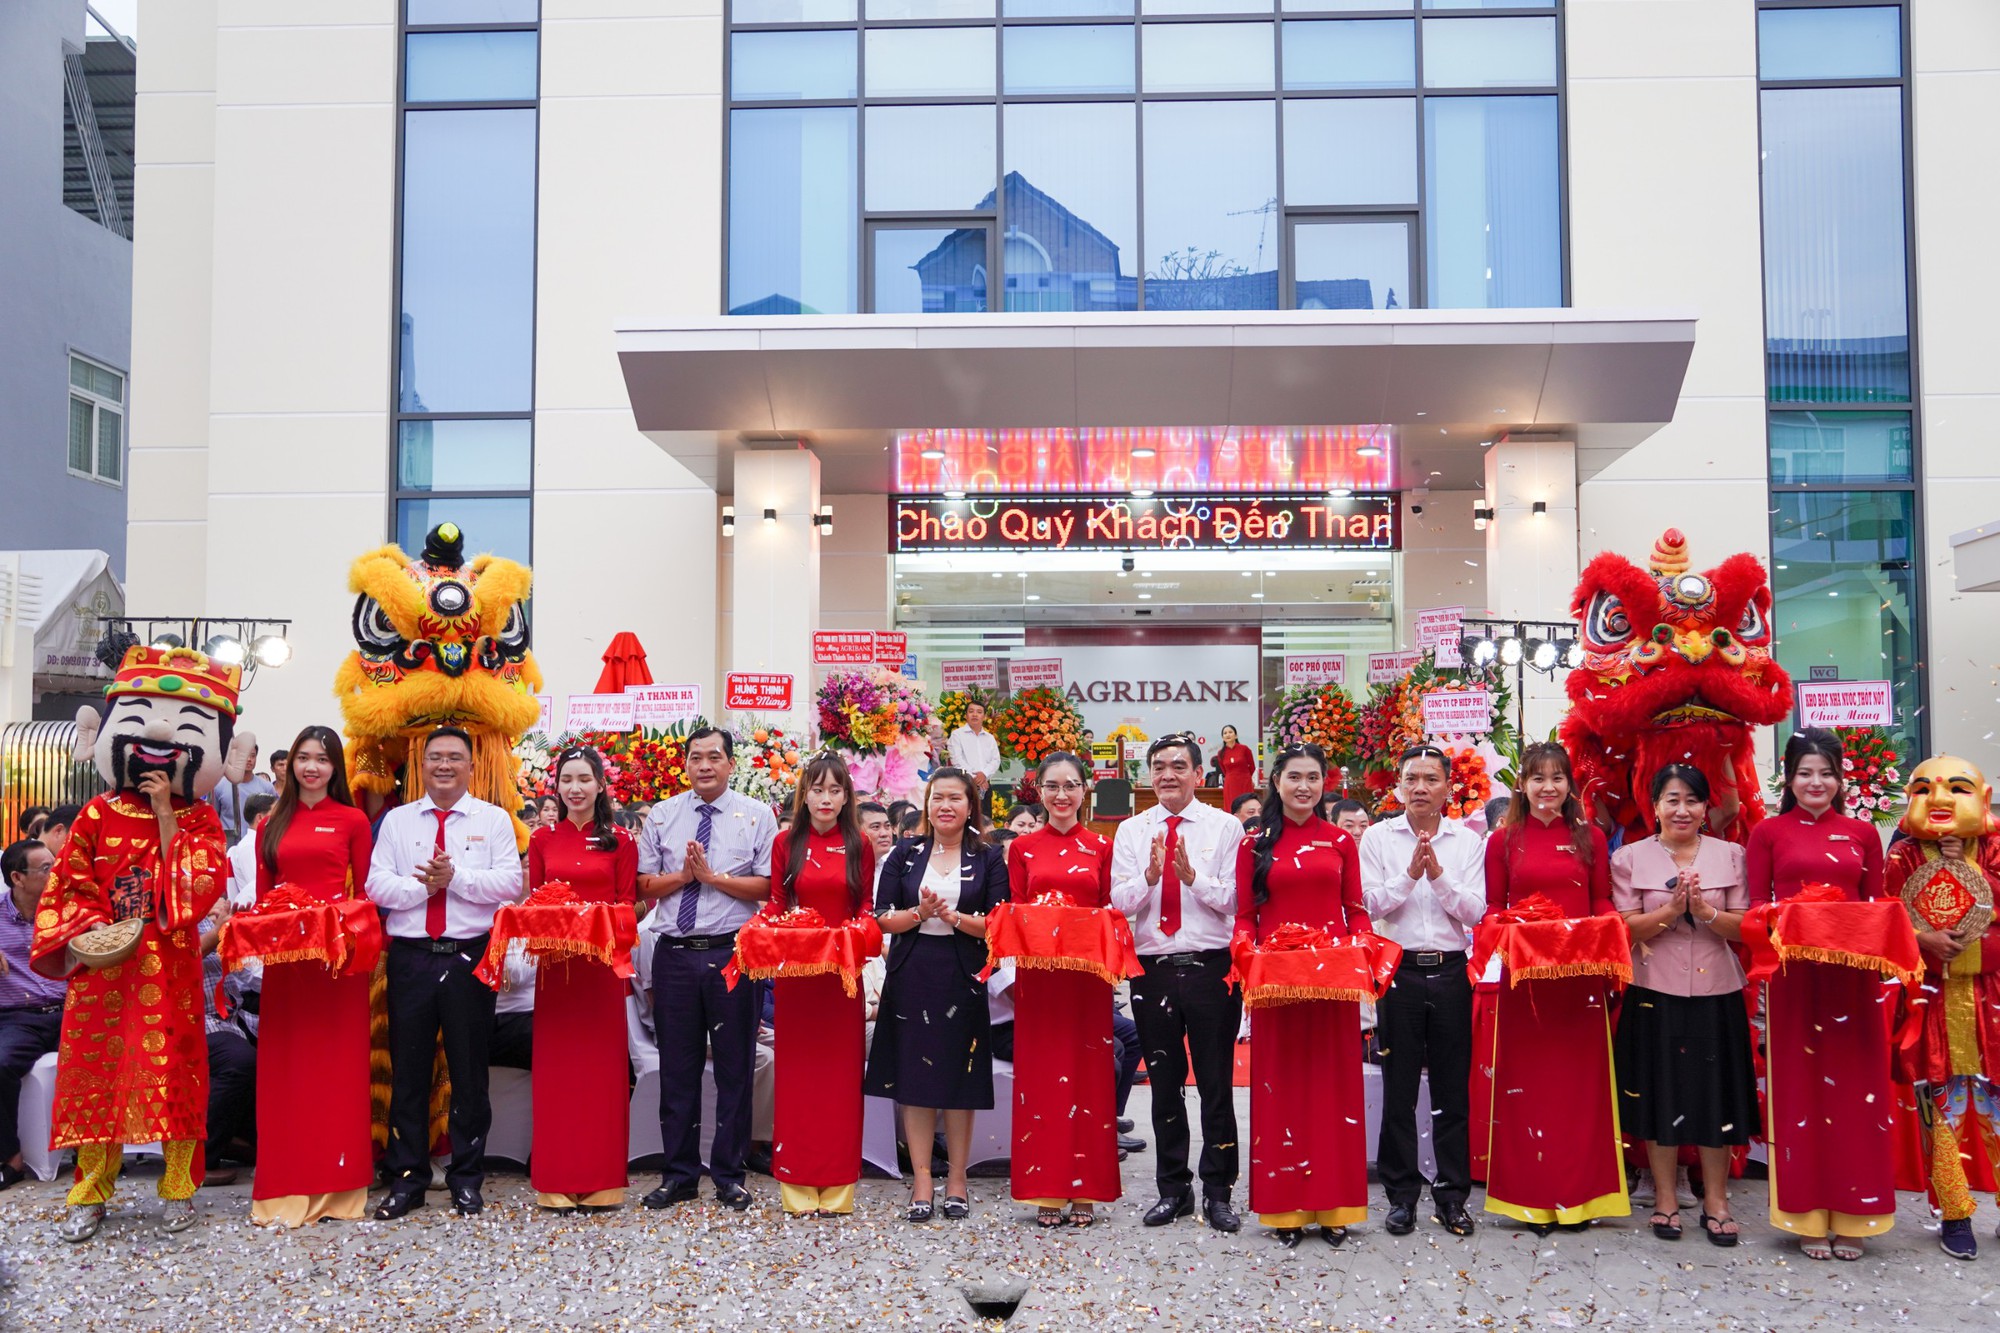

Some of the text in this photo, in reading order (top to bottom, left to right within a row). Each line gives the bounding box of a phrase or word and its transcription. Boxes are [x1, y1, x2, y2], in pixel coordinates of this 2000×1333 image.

[1000, 508, 1074, 549] Quý
[1087, 506, 1200, 541] Khách
[1212, 500, 1288, 540] Đến
[1301, 506, 1391, 540] Than
[1440, 638, 1453, 646] CTY
[1813, 669, 1835, 677] WC
[647, 691, 678, 700] THANH
[734, 683, 784, 696] HƯNG THỊNH
[1066, 680, 1249, 702] AGRIBANK
[730, 694, 787, 708] Chúc Mừng
[1428, 697, 1442, 708] CÔNG
[1805, 694, 1816, 707] KHO
[1810, 709, 1880, 721] Chúc Mừng
[569, 716, 628, 727] Chúc Mừng
